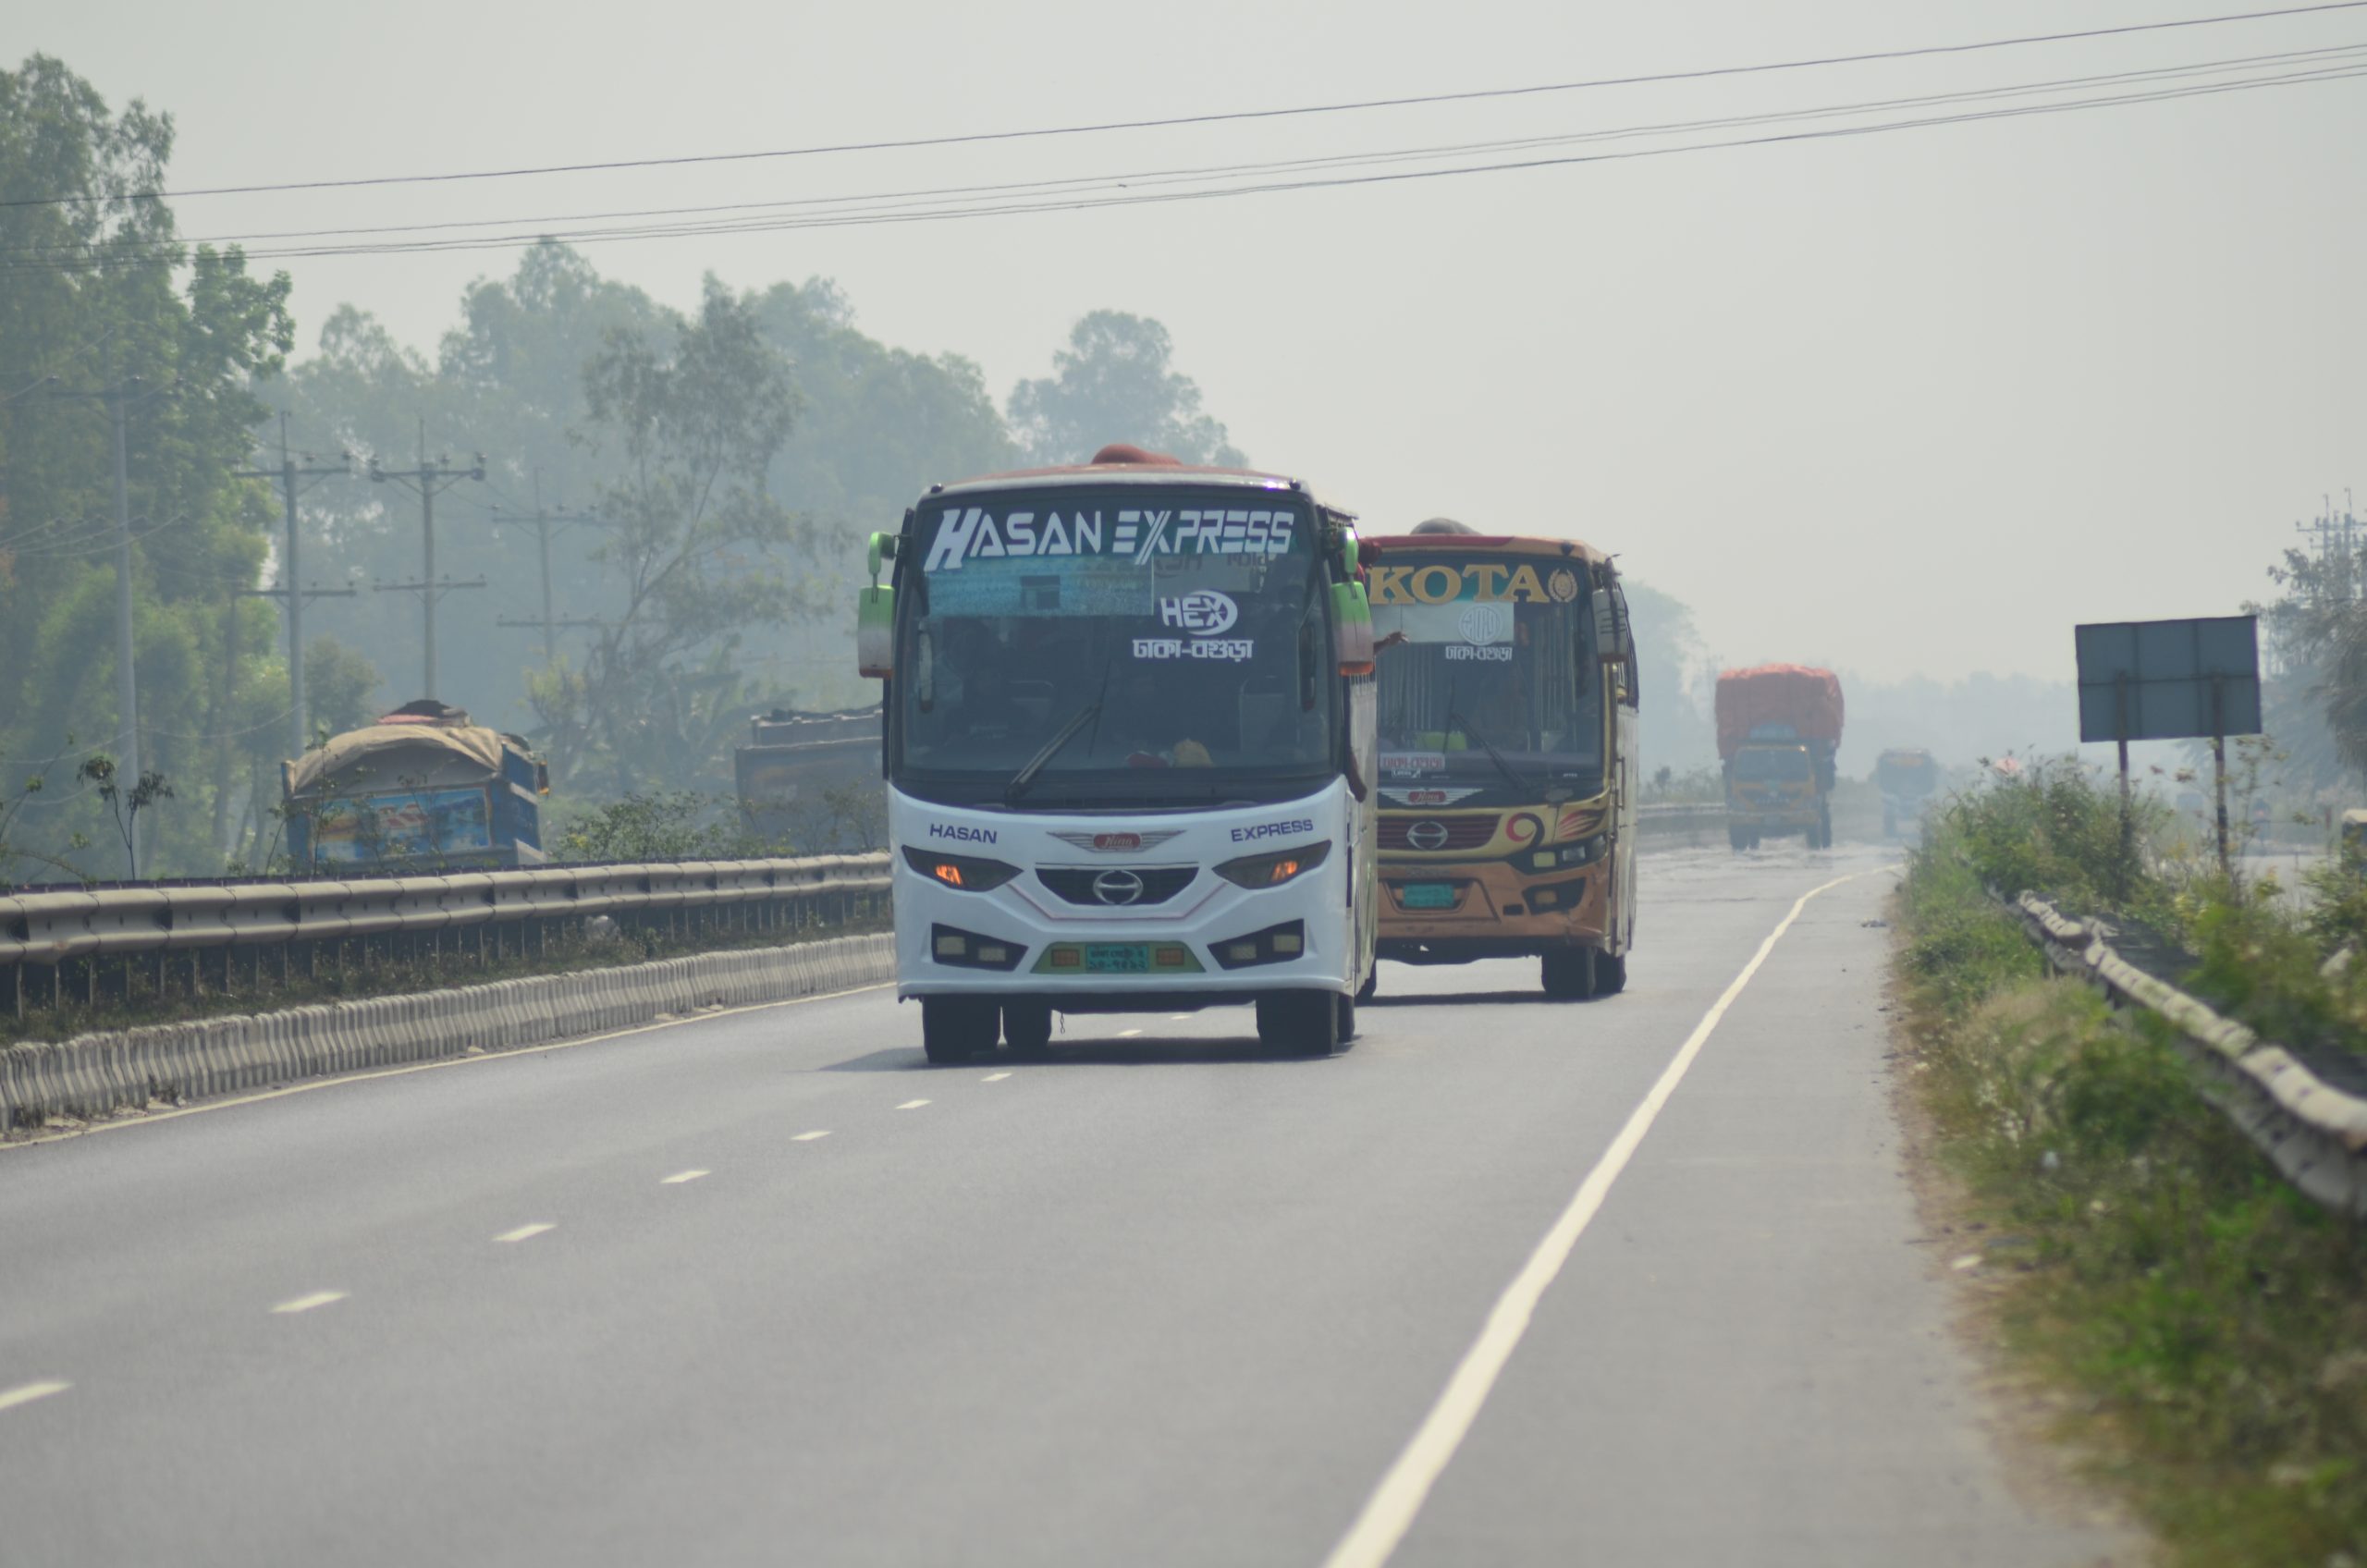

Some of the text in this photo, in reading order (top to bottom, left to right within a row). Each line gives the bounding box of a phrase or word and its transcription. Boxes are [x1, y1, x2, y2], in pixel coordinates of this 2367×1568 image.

[924, 508, 1102, 571] HASAN
[1111, 509, 1294, 565] EXPRESS
[1159, 591, 1238, 635] HEX
[1133, 640, 1254, 662] ঢাকা-বগুড়া
[929, 819, 1314, 844] HASAN EXPRESS
